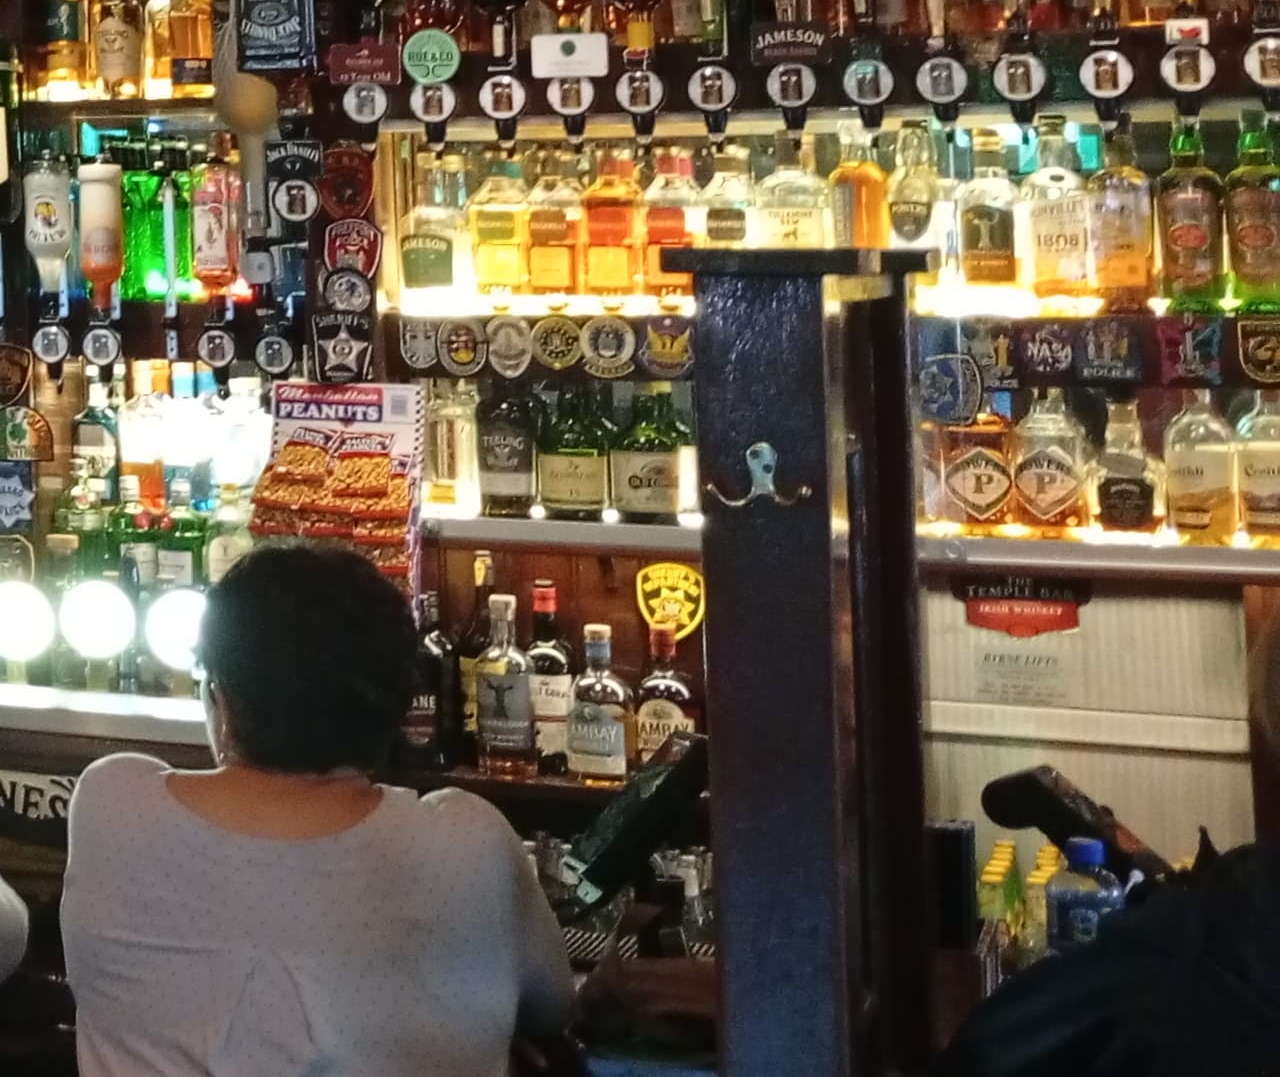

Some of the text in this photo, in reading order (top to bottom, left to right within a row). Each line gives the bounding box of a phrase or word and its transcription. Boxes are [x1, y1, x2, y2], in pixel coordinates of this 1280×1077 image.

[756, 29, 825, 48] JAMESON
[266, 143, 286, 162] JACK
[1036, 233, 1080, 248] 1808
[1026, 341, 1073, 362] NASA
[1081, 367, 1136, 379] POLICE
[278, 402, 380, 420] PEANUTS
[482, 434, 525, 451] TEELING
[972, 473, 994, 495] P
[1035, 473, 1058, 495] P
[1008, 575, 1033, 586] THE
[966, 584, 1074, 599] TEMPLE BAR
[978, 603, 1064, 616] IRISH WHISKEY
[411, 694, 437, 708] ANE
